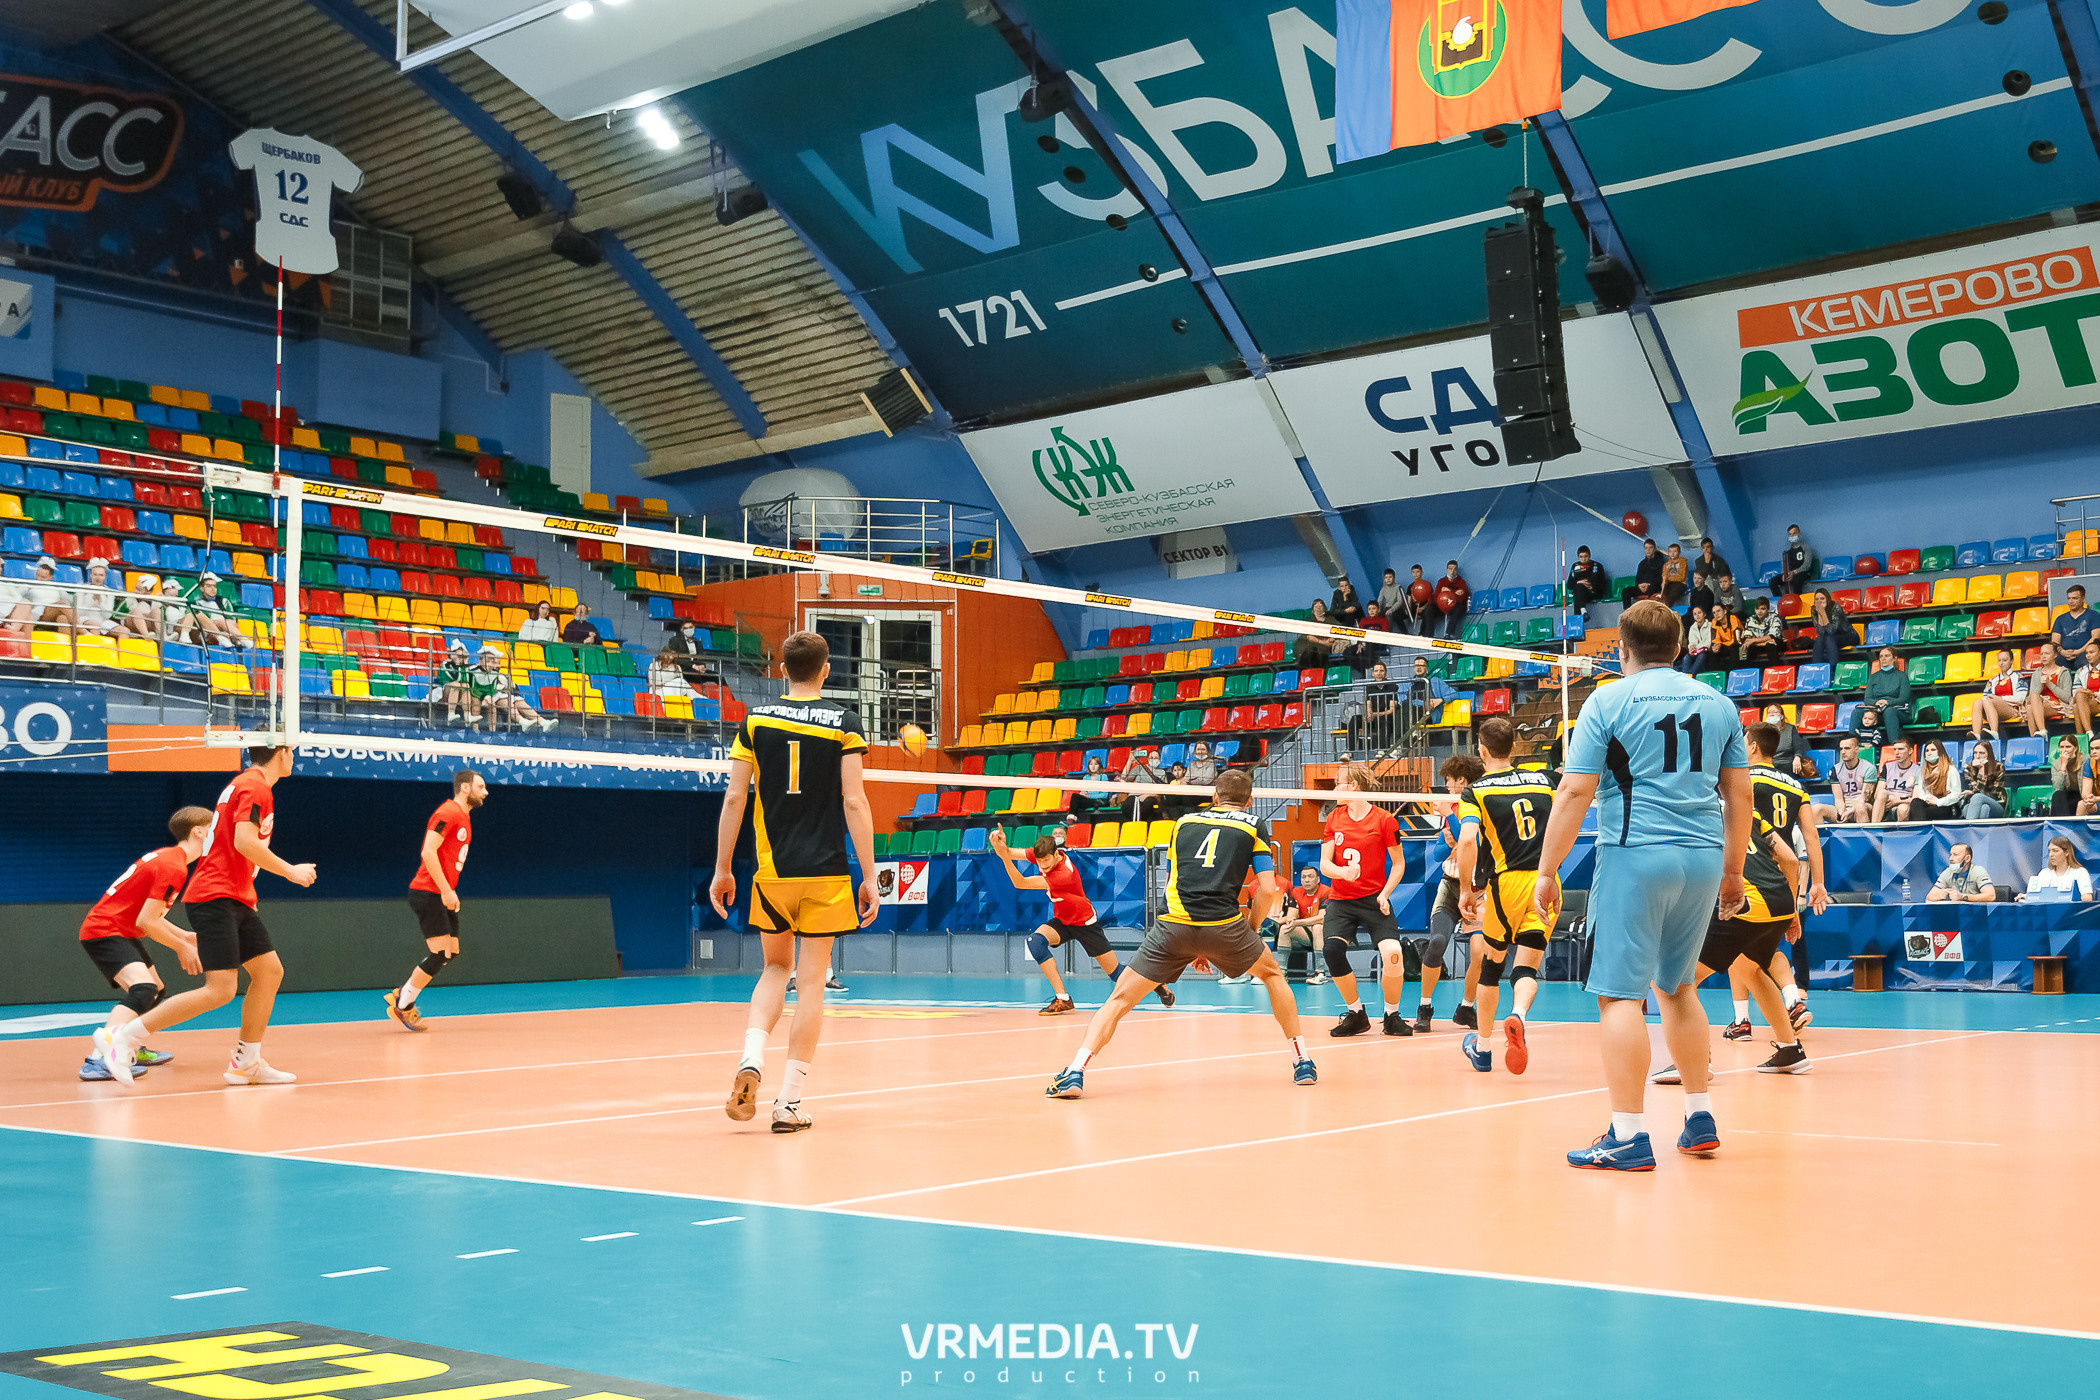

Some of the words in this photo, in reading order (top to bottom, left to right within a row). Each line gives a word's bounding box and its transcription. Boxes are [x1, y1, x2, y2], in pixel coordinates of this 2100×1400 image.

[0, 91, 163, 176] АСС
[261, 141, 322, 165] ЩЕРБАКОВ
[25, 176, 83, 201] КЛУБ
[275, 169, 310, 205] 12
[1788, 253, 2084, 337] КЕМЕРОВО
[938, 289, 1048, 348] 1721
[1732, 292, 2100, 435] АЗОТ
[1365, 366, 1506, 436] СД
[1390, 438, 1501, 477] УГО
[1087, 478, 1236, 513] СЕВЕРО-КУЗБАССКАЯ
[1096, 496, 1217, 524] ЭНЕРГЕТИЧЕСКАЯ
[545, 518, 577, 530] PARI
[577, 522, 618, 537] MATCH
[1104, 515, 1180, 536] КОМПАНИЯ
[754, 547, 781, 559] PARI
[781, 550, 816, 563] MATCH
[1163, 546, 1210, 565] СЕКТОР
[0, 701, 73, 757] О
[1653, 712, 1703, 774] 11
[786, 740, 802, 795] 1
[1892, 778, 1907, 790] 14
[1845, 781, 1858, 793] 13
[1511, 798, 1537, 842] 6
[1771, 792, 1787, 829] 8
[1193, 828, 1221, 868] 4
[1342, 847, 1361, 880] 3
